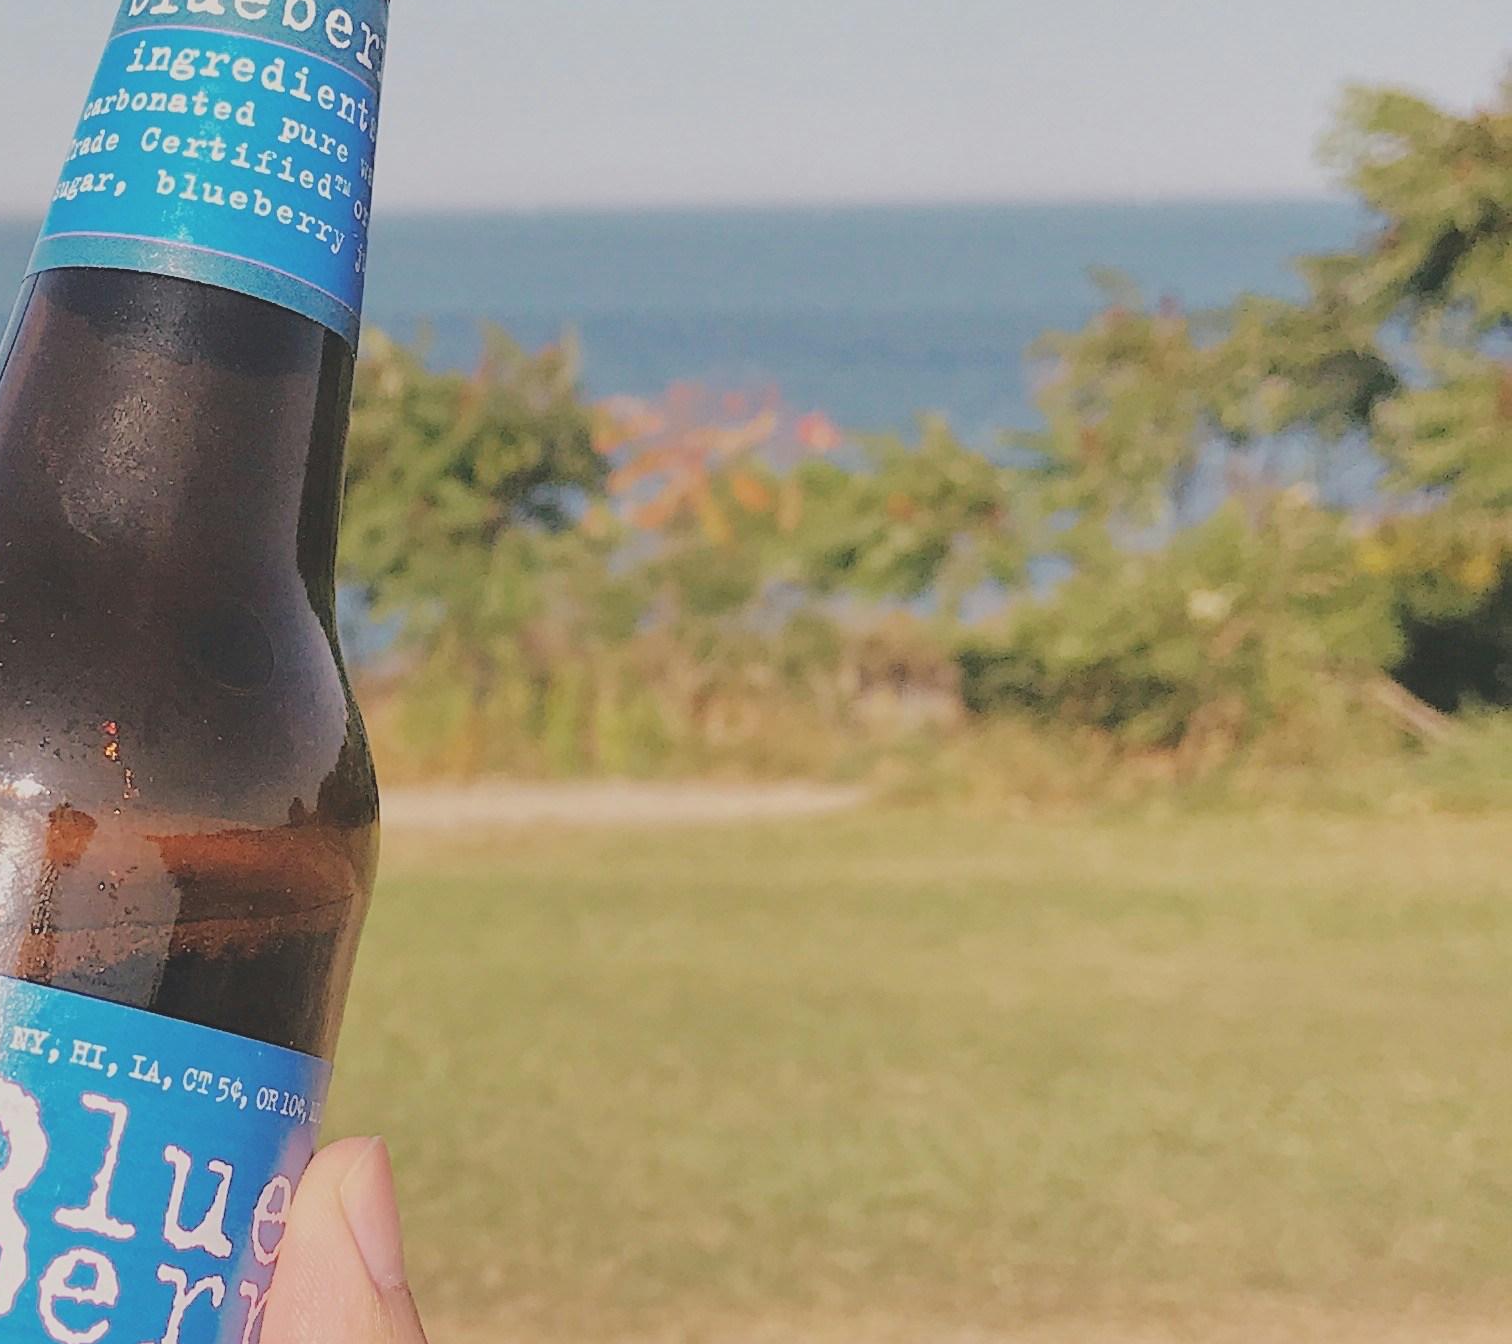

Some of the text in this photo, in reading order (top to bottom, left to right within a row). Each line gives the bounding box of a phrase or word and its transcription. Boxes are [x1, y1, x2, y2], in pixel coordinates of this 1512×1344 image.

[83, 88, 348, 162] carbonated pure
[53, 173, 126, 201] sugar,
[156, 169, 345, 254] blueberry
[9, 1026, 59, 1063] NY,
[69, 1039, 118, 1077] HI,
[128, 1055, 172, 1090] IA,
[183, 1067, 213, 1095] CT
[215, 1077, 247, 1110] 5¢,
[256, 1087, 278, 1111] OR
